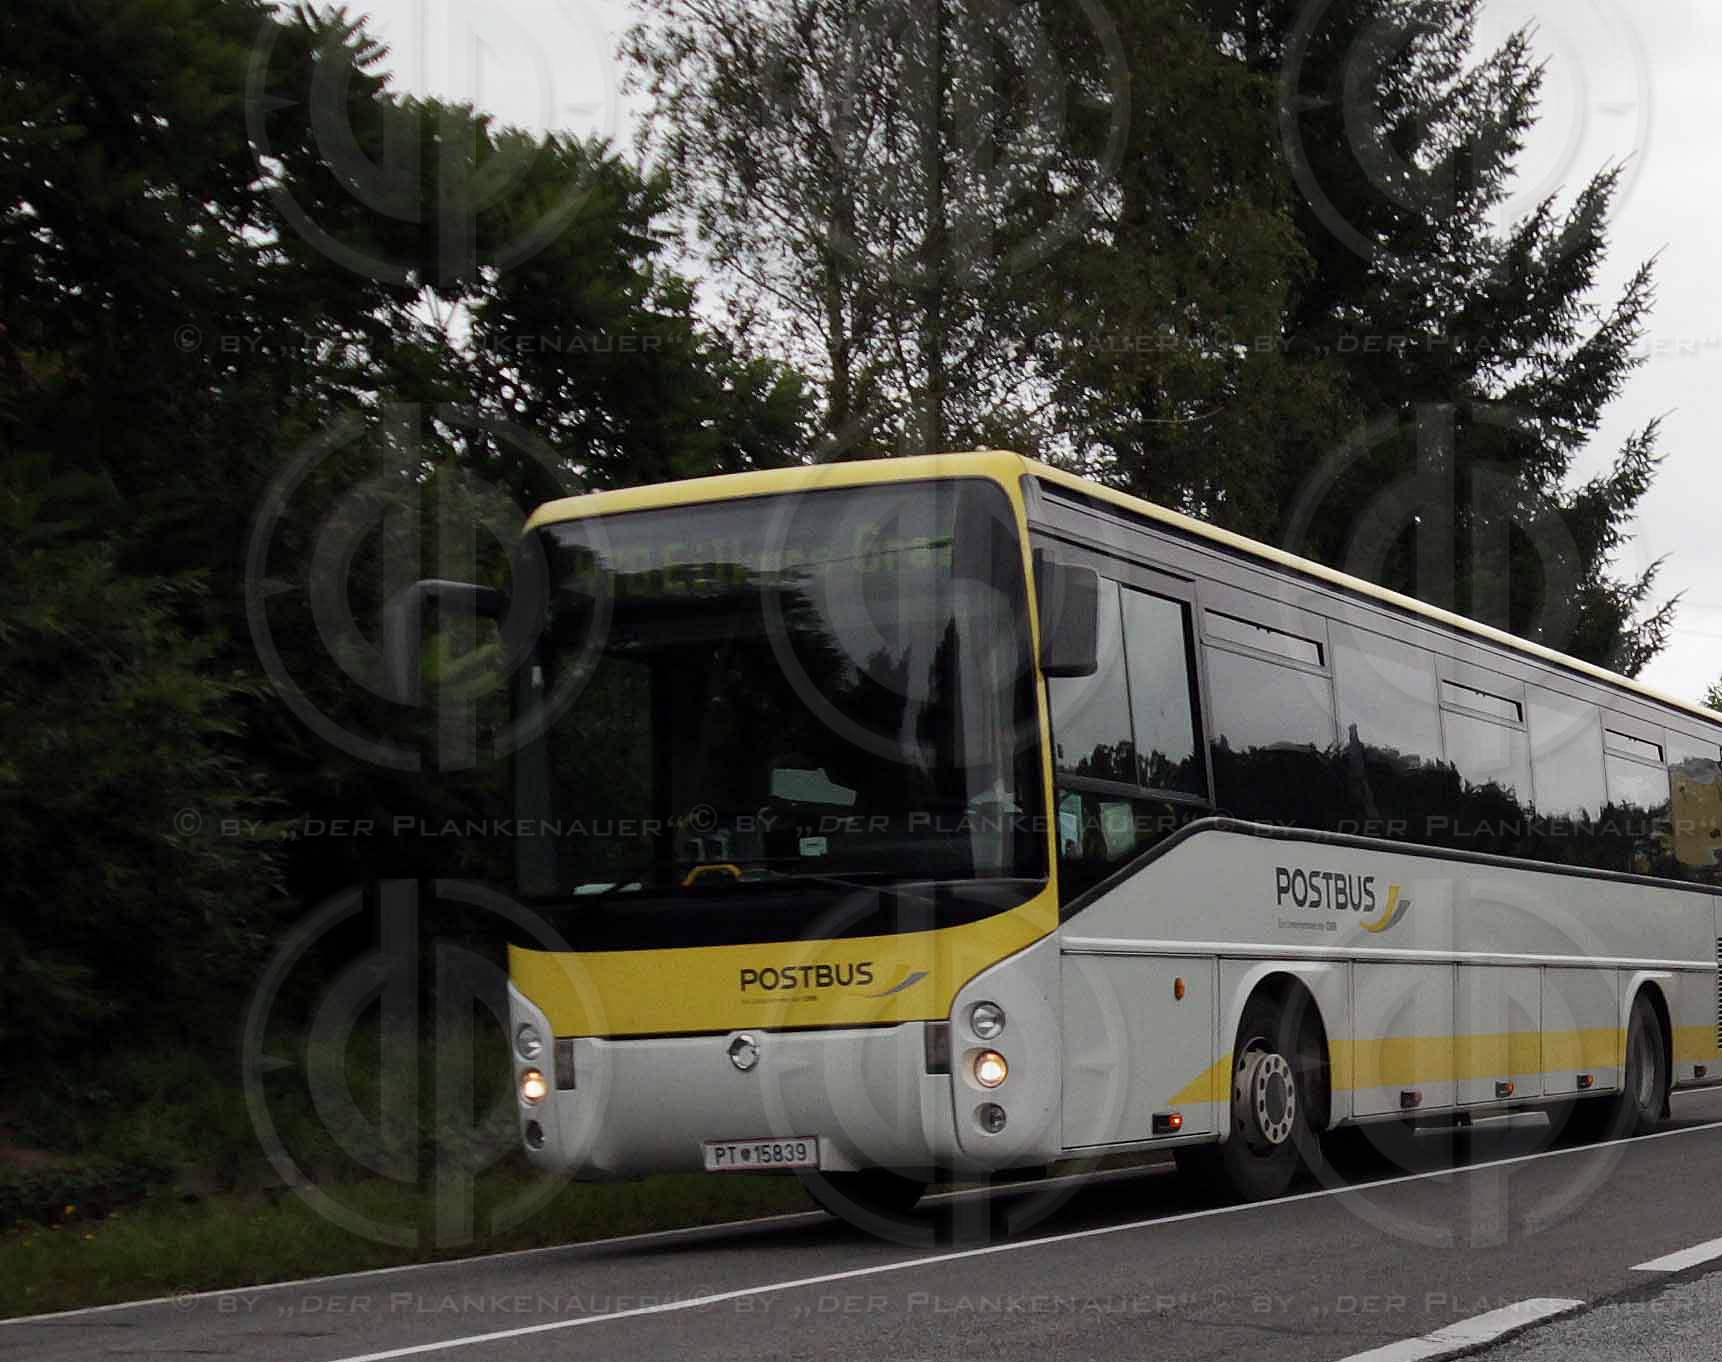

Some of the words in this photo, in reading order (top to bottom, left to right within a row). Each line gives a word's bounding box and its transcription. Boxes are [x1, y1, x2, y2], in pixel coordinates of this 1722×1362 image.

[1276, 867, 1375, 912] POSTBUS
[740, 962, 873, 991] POSTBUS
[715, 1147, 737, 1164] PT
[754, 1143, 807, 1163] 15839
